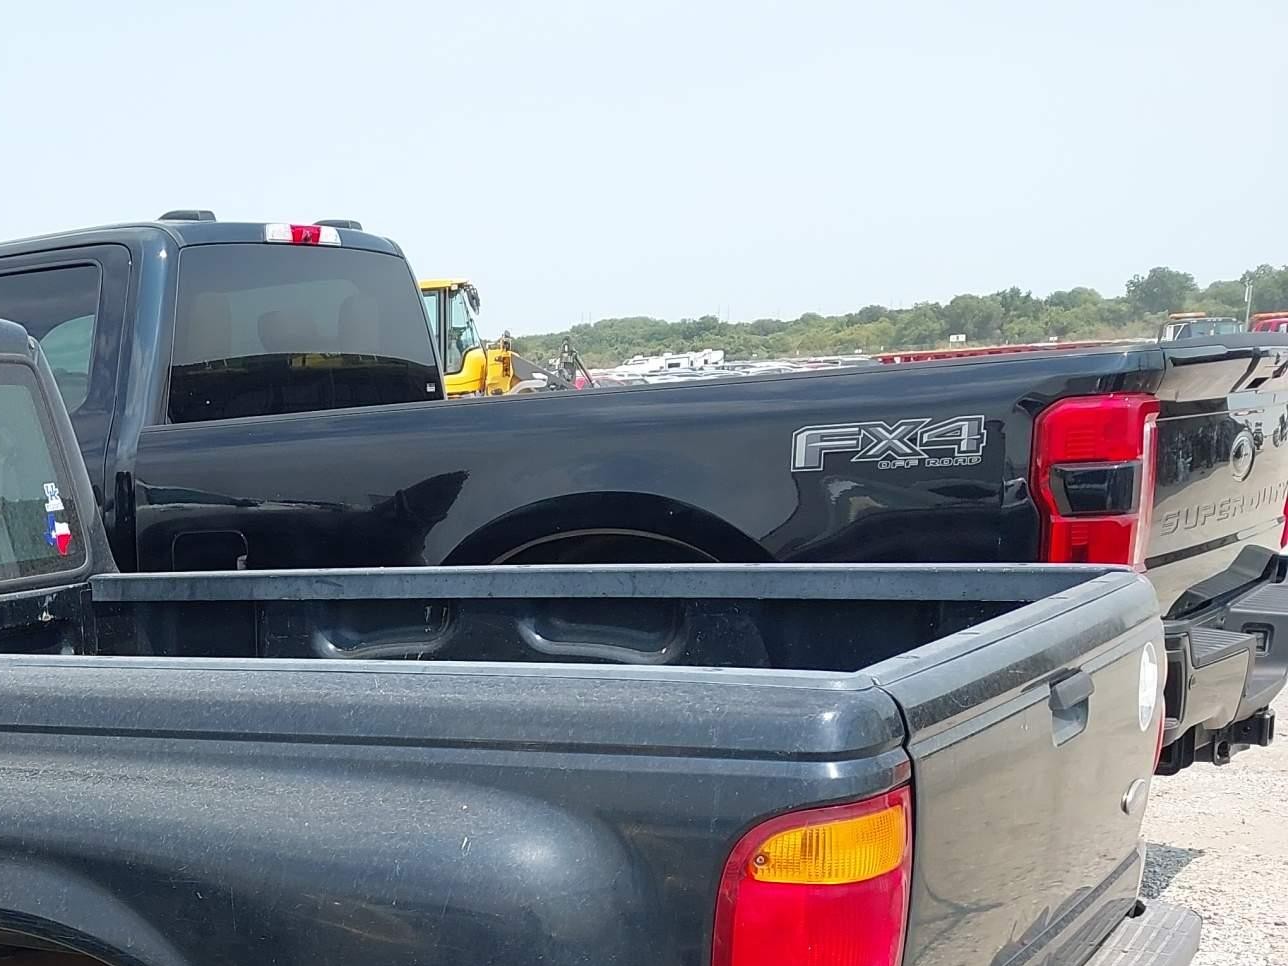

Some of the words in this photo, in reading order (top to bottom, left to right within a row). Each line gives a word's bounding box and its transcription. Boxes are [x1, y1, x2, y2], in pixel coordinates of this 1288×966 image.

[791, 415, 987, 472] FX4
[877, 460, 919, 470] OFF
[925, 456, 982, 467] ROAD
[1159, 496, 1246, 537] SUPER
